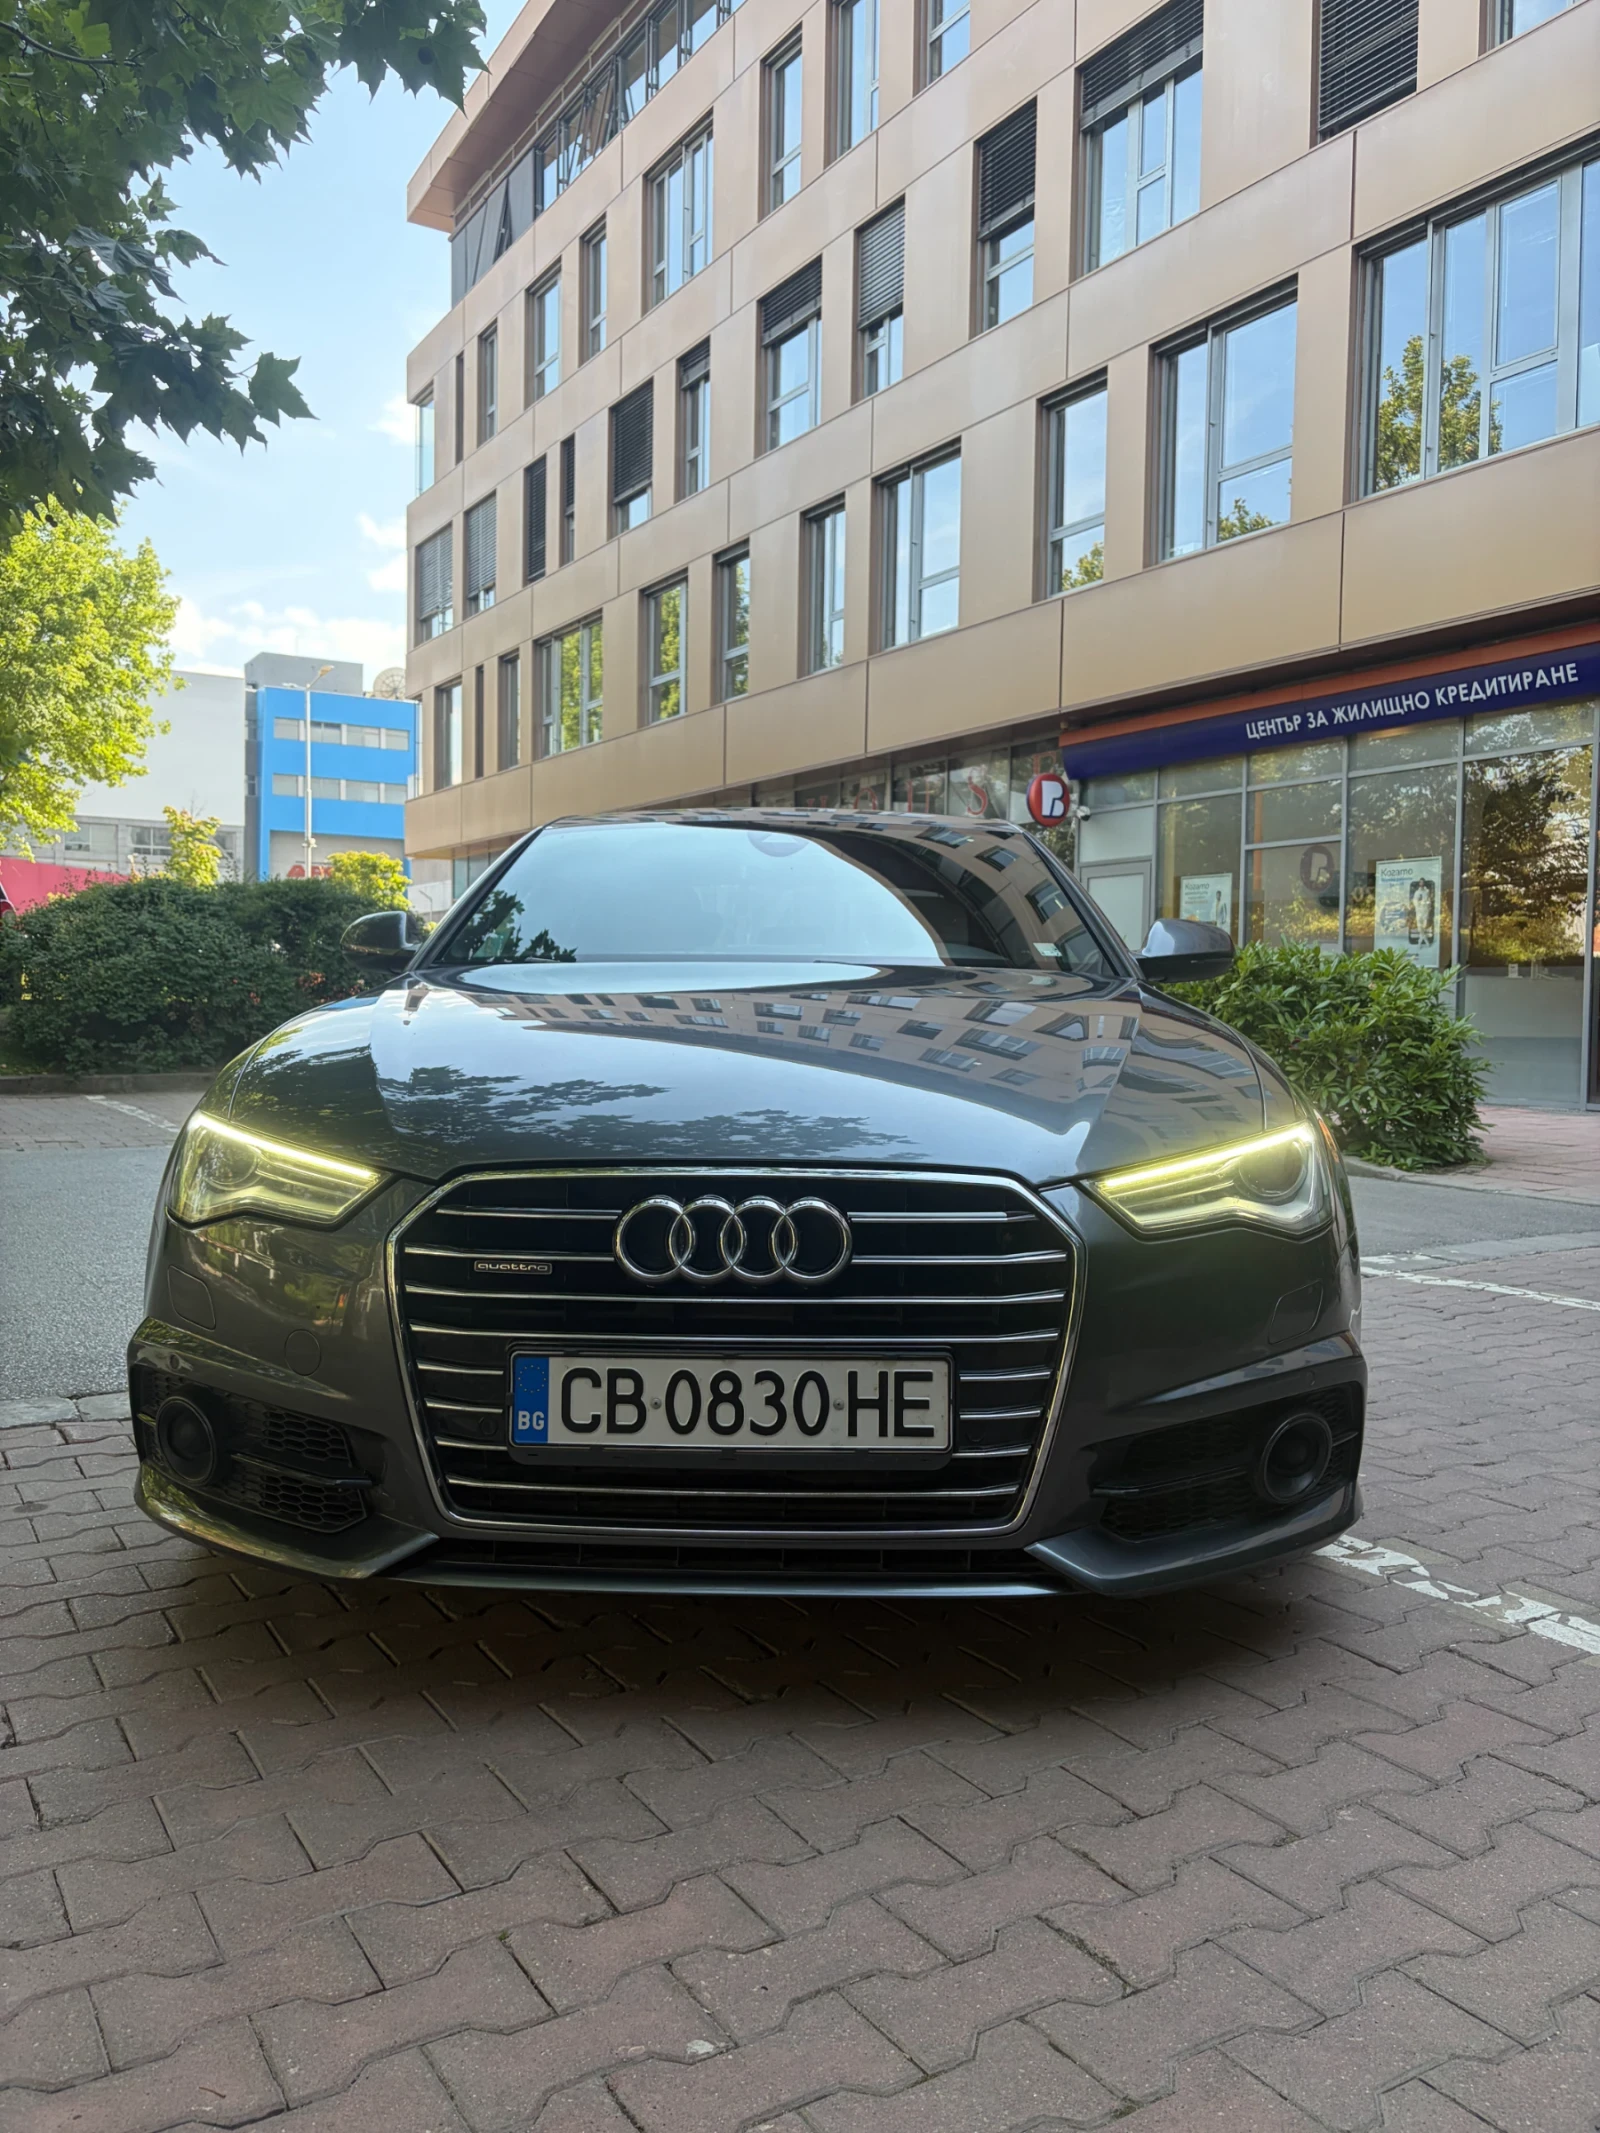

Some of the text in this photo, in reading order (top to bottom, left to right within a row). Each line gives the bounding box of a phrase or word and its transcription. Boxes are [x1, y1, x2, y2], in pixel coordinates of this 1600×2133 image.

[1246, 663, 1579, 740] ЦЕНТЪР ЗА ЖИЛИЩНО КРЕДИТИРАНЕ
[477, 1263, 548, 1271] quattro
[517, 1410, 545, 1431] BG
[664, 1369, 830, 1436] 0830
